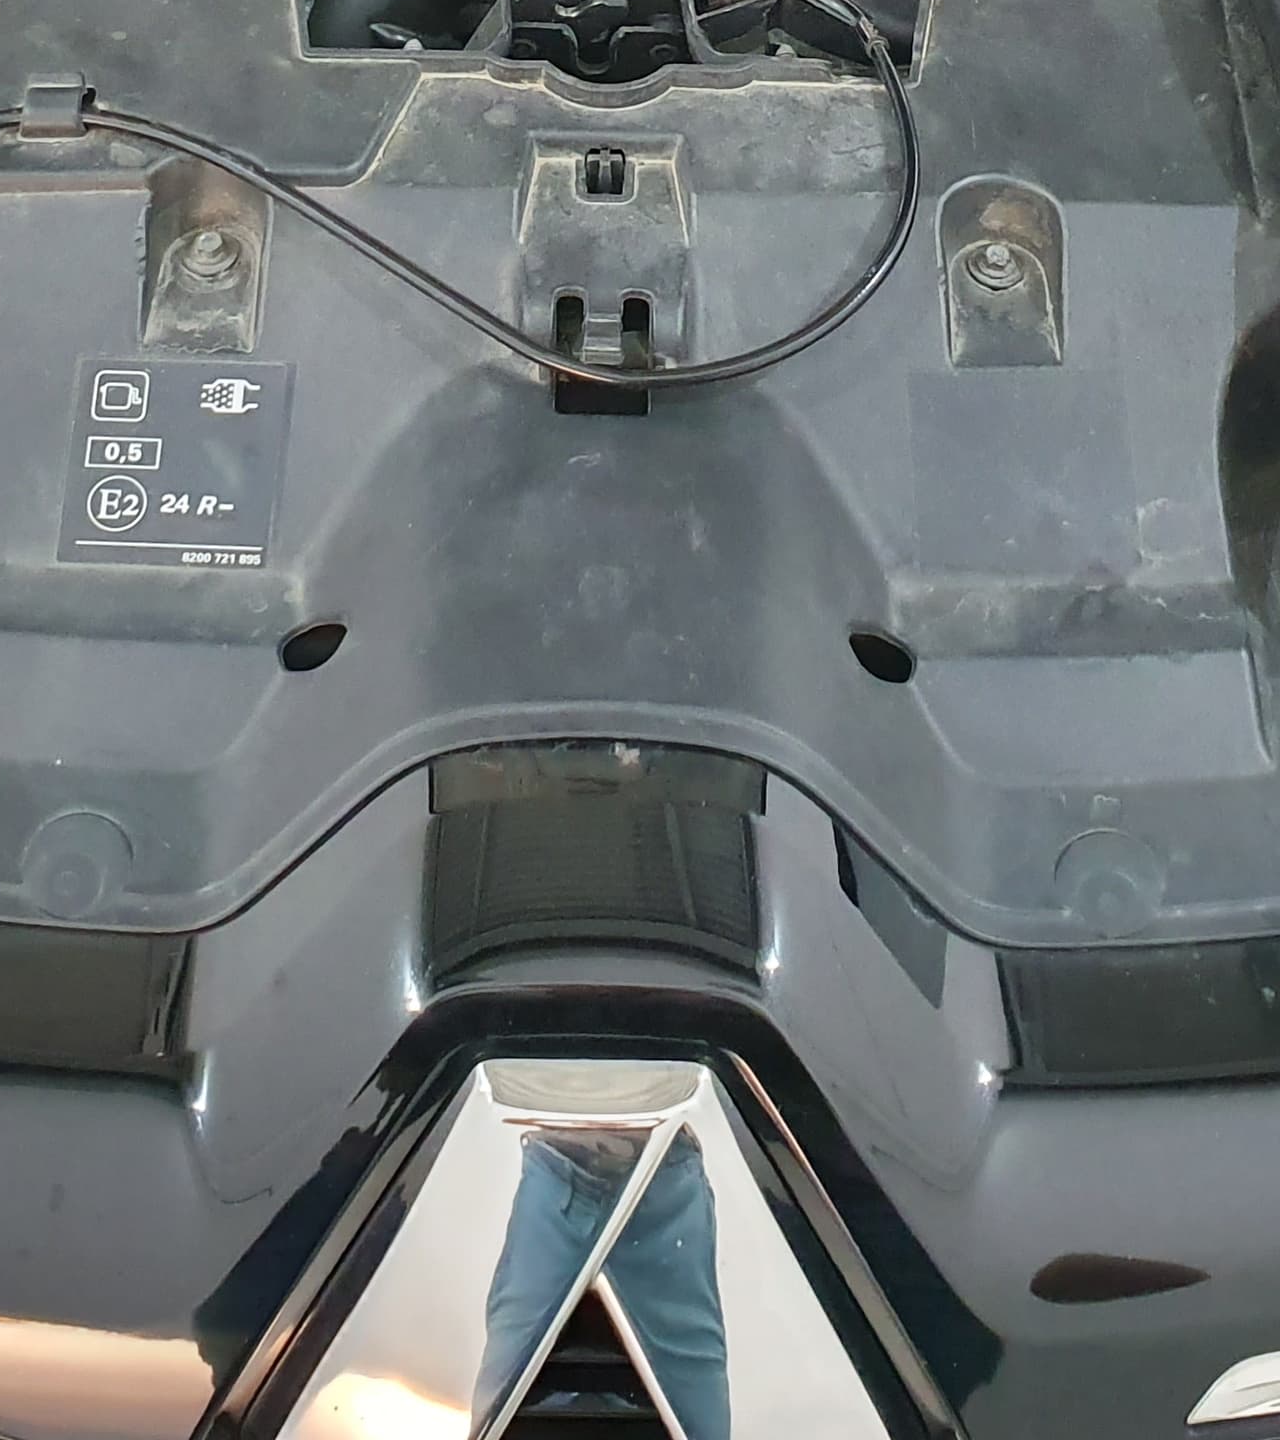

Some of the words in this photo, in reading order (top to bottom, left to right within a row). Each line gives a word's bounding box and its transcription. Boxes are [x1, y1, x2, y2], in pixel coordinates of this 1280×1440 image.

[104, 442, 143, 464] 0,5
[96, 488, 140, 521] E2
[159, 493, 190, 514] 24
[181, 551, 211, 564] 8200
[214, 553, 236, 565] 721
